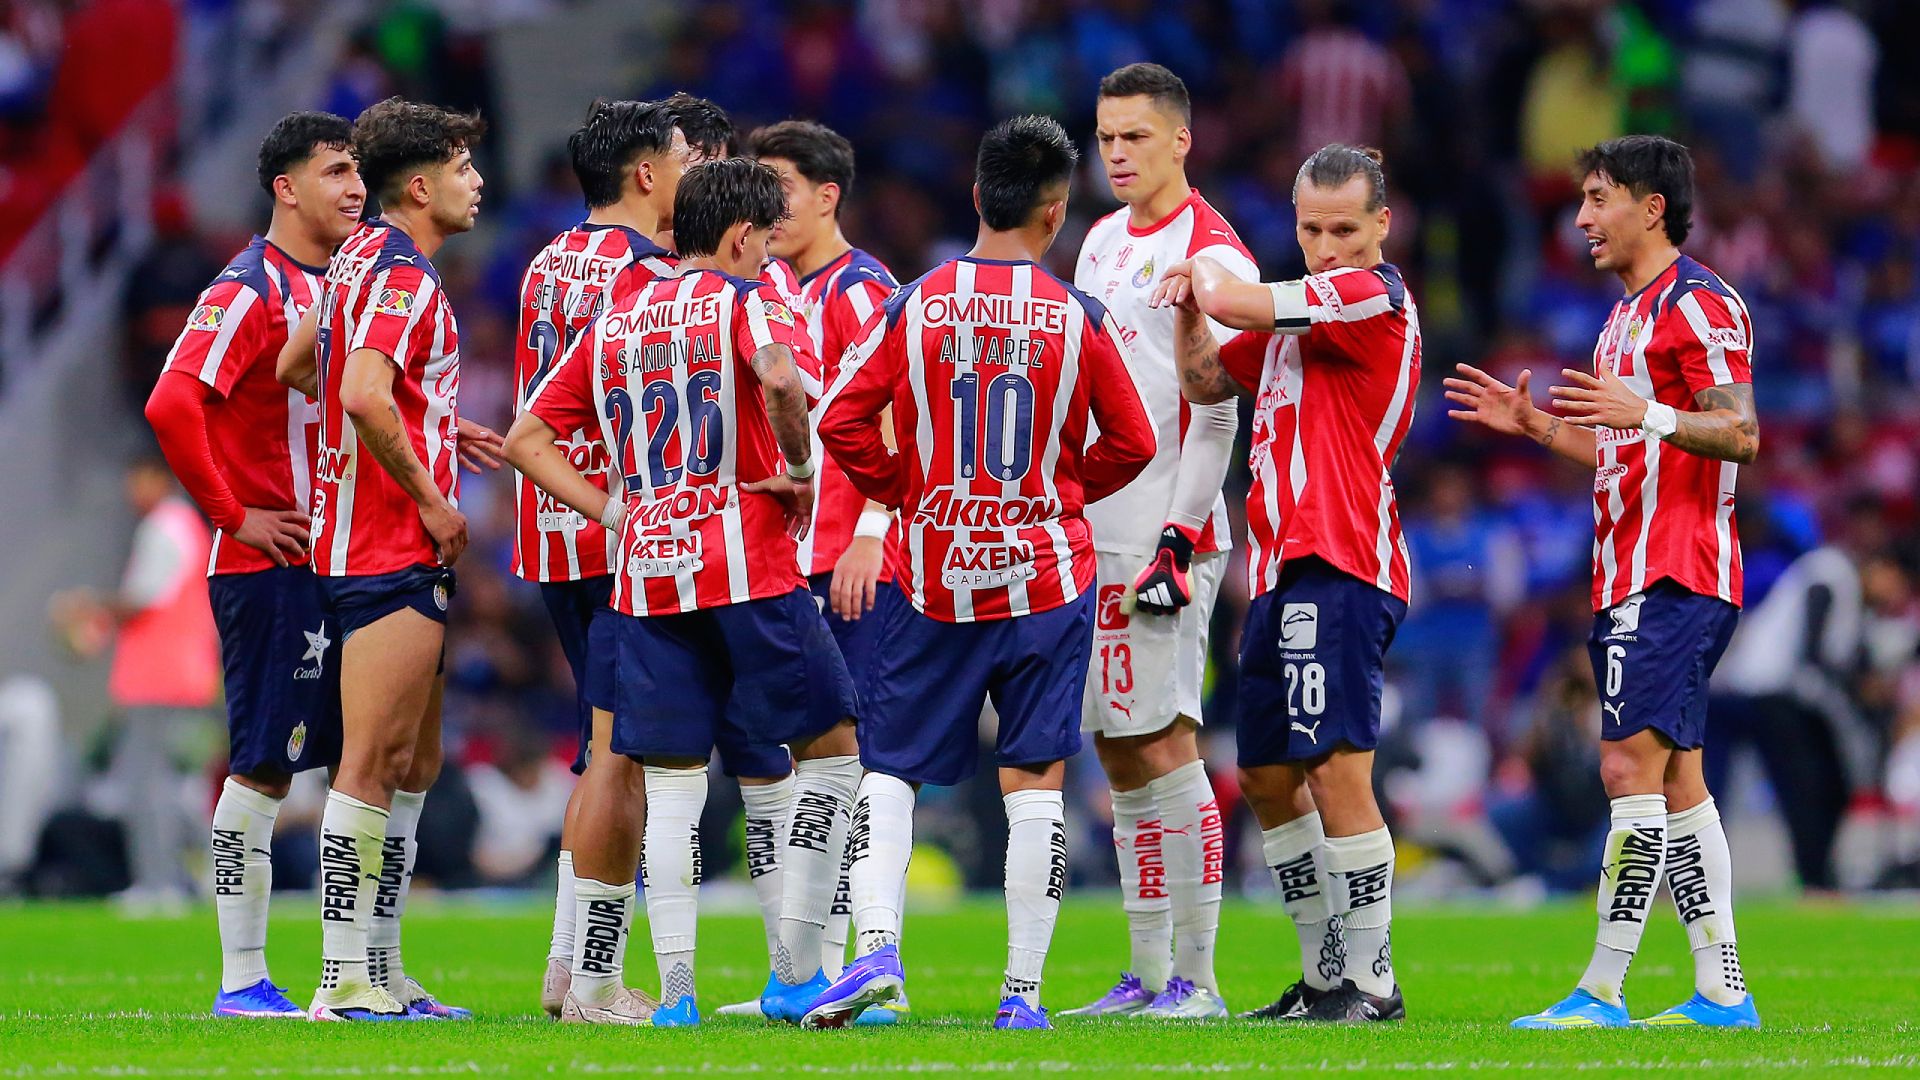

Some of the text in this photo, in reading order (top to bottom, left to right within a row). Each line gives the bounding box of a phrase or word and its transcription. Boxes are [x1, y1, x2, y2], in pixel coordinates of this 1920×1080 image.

[605, 297, 716, 338] OMNILIFE
[923, 297, 1060, 330] OMNILIFE
[617, 333, 721, 376] SANDOVAL
[939, 335, 1046, 368] ALVAREZ
[604, 372, 723, 493] 226
[951, 373, 1035, 482] 10
[913, 490, 1056, 527] AKRON
[629, 559, 699, 573] CAPITAL
[946, 567, 1033, 585] CAPITAL
[947, 544, 1031, 571] AXEN
[1100, 643, 1134, 694] 13
[1284, 662, 1326, 717] 28
[1606, 645, 1627, 697] 6
[745, 818, 778, 880] PERDURA
[788, 790, 839, 853] PERDURA
[1198, 801, 1224, 886] PERDURA
[213, 828, 246, 896] PERDURA
[321, 833, 361, 923] PERDURA
[1046, 821, 1067, 902] PERDURA
[1134, 819, 1169, 899] PERDURA
[1609, 826, 1664, 924] PERDURA
[581, 898, 625, 974] PERDUR
